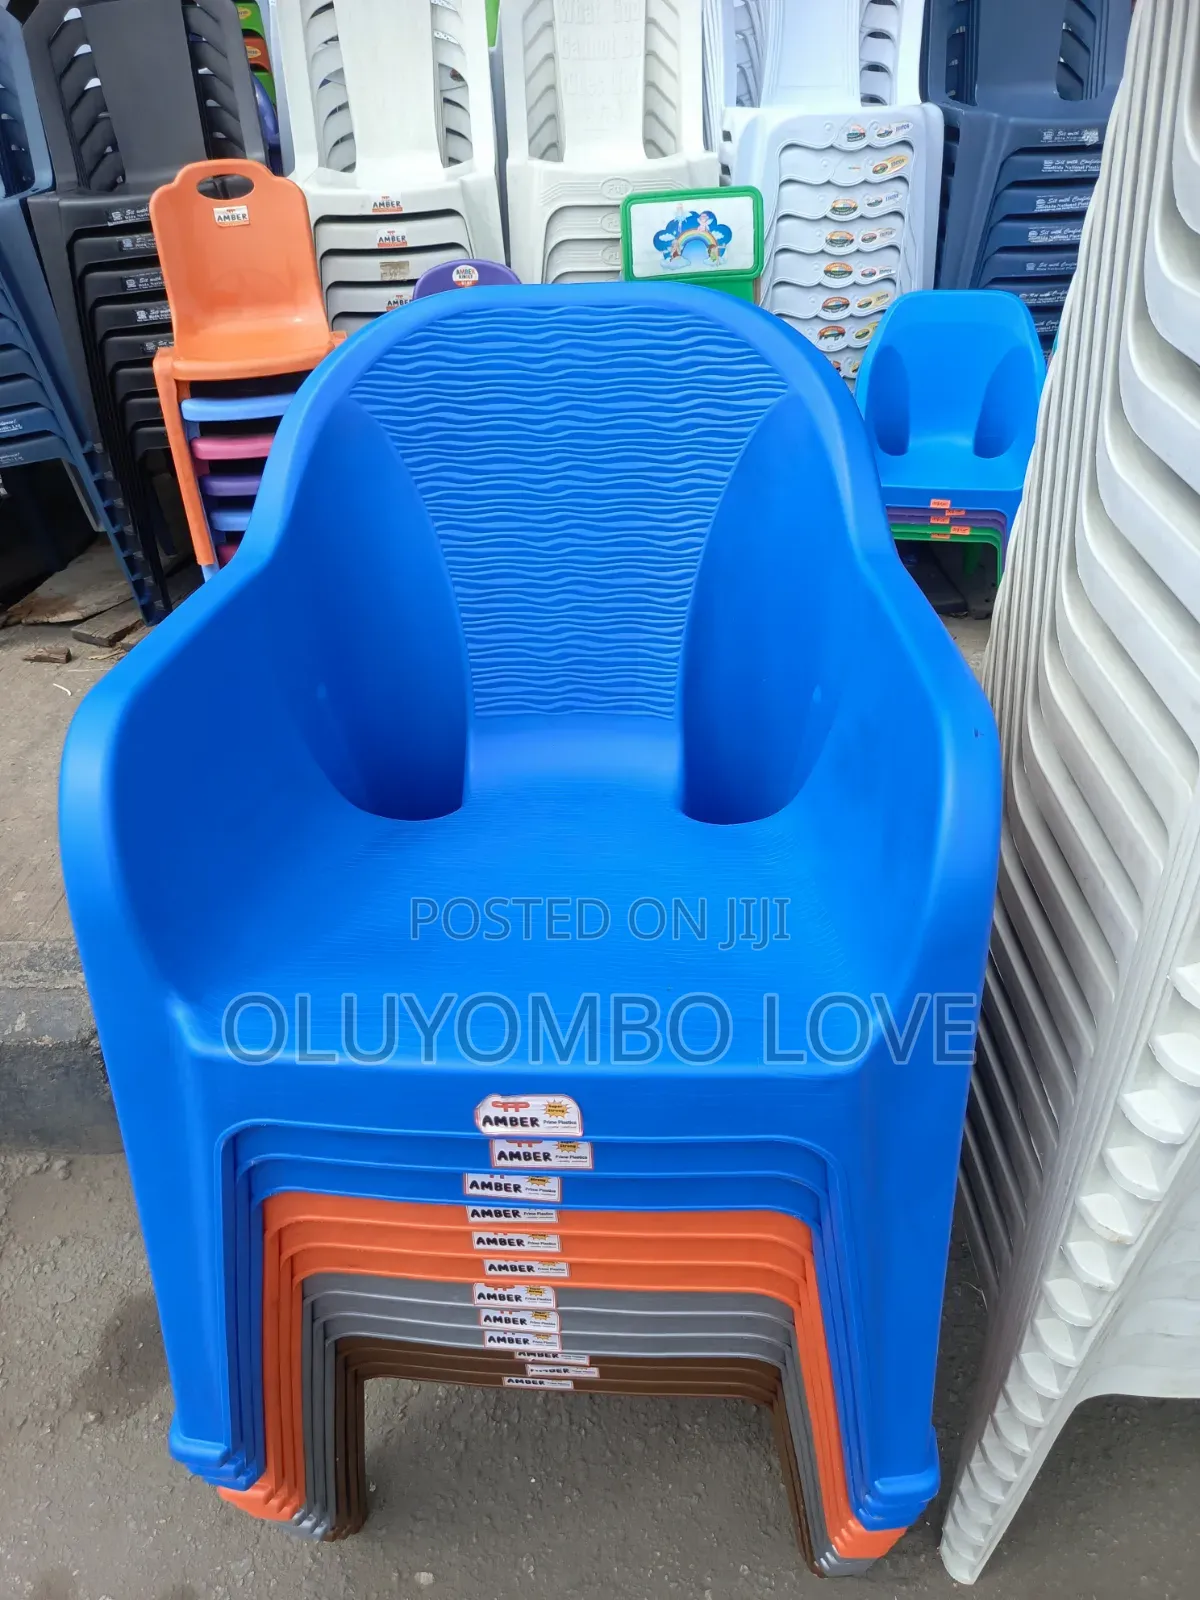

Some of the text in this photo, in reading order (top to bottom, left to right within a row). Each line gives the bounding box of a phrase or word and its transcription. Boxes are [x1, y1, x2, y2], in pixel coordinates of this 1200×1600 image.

[372, 200, 401, 208] AMBER
[217, 213, 247, 222] AMBER
[378, 235, 406, 243] AMBER
[482, 1115, 541, 1128] AMBER
[497, 1150, 553, 1162] AMBER
[469, 1180, 522, 1193] AMBER
[470, 1208, 522, 1218] AMBER
[476, 1236, 525, 1247] AMBER
[488, 1263, 535, 1273] AMBER
[477, 1292, 523, 1302] AMBER
[483, 1314, 528, 1326] AMBER
[488, 1335, 531, 1345] AMBER
[507, 1378, 545, 1386] AMBER
